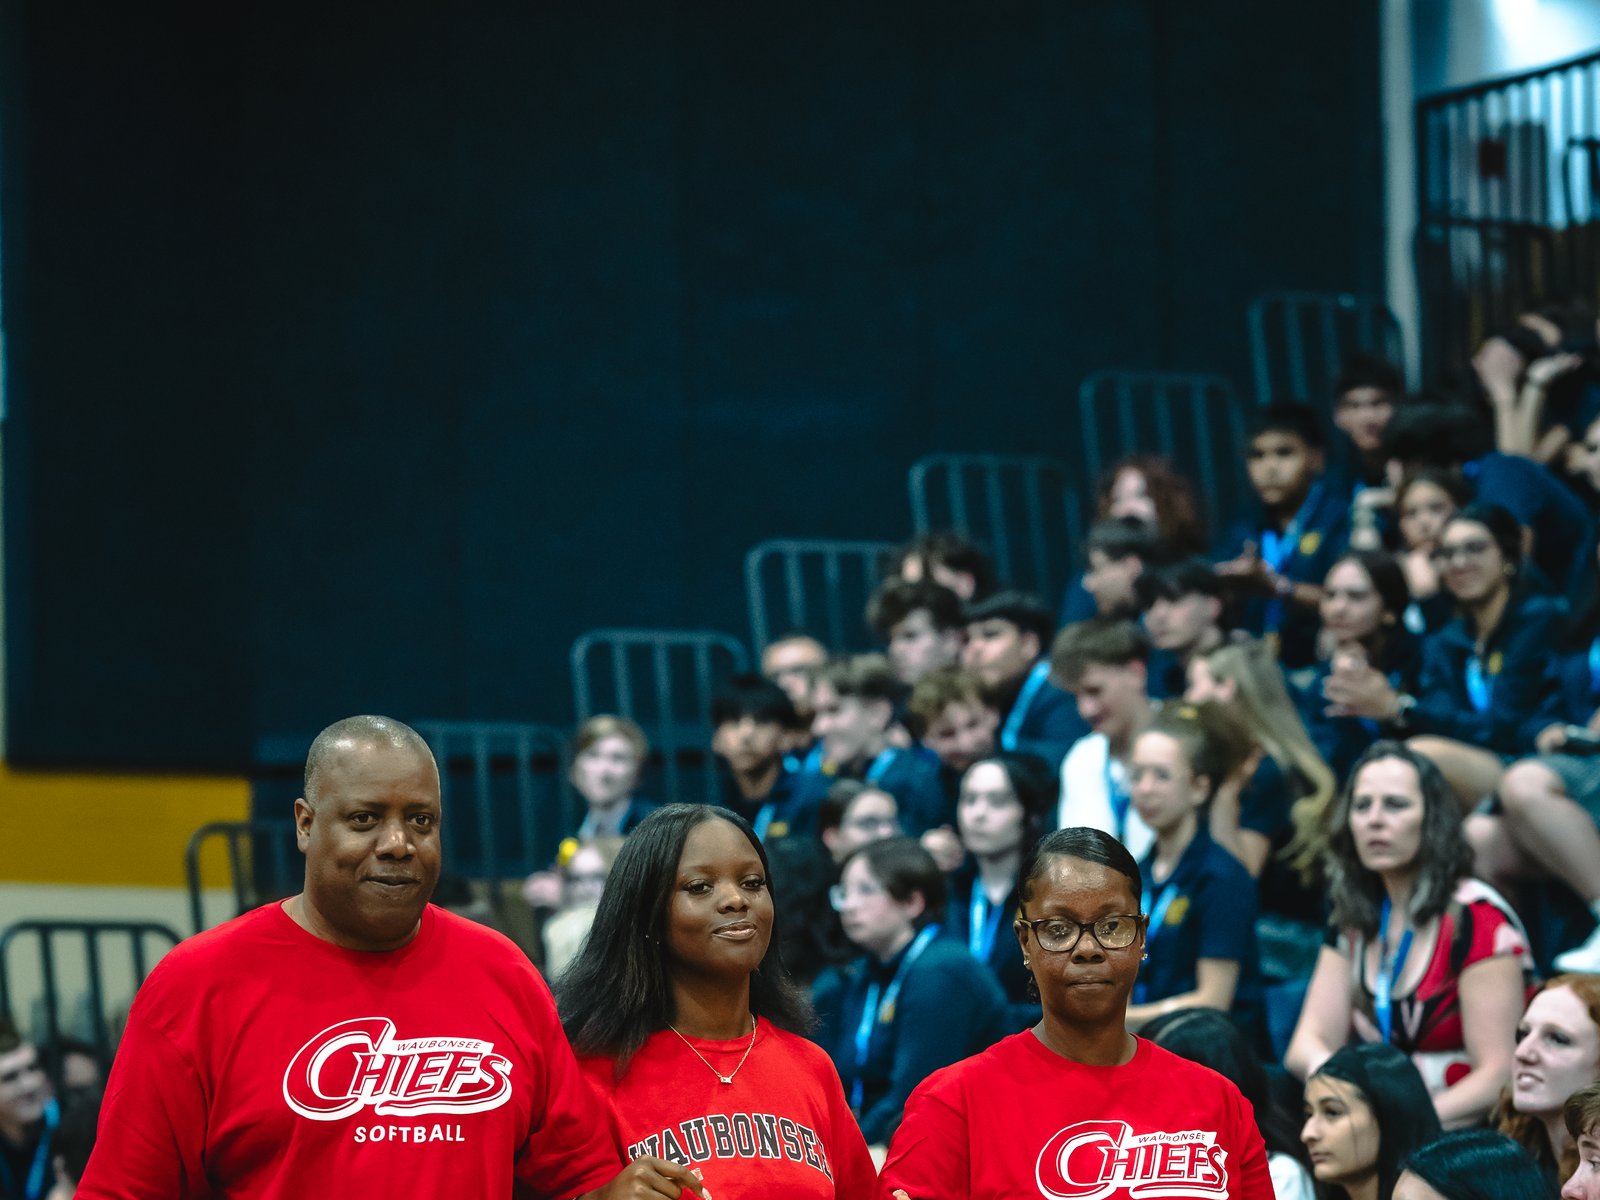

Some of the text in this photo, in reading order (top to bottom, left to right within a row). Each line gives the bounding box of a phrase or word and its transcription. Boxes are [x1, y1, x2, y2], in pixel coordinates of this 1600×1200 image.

[397, 1040, 482, 1051] WAUBONSEE
[354, 1125, 465, 1143] SOFTBALL
[1138, 1132, 1206, 1143] WAUBONSEE
